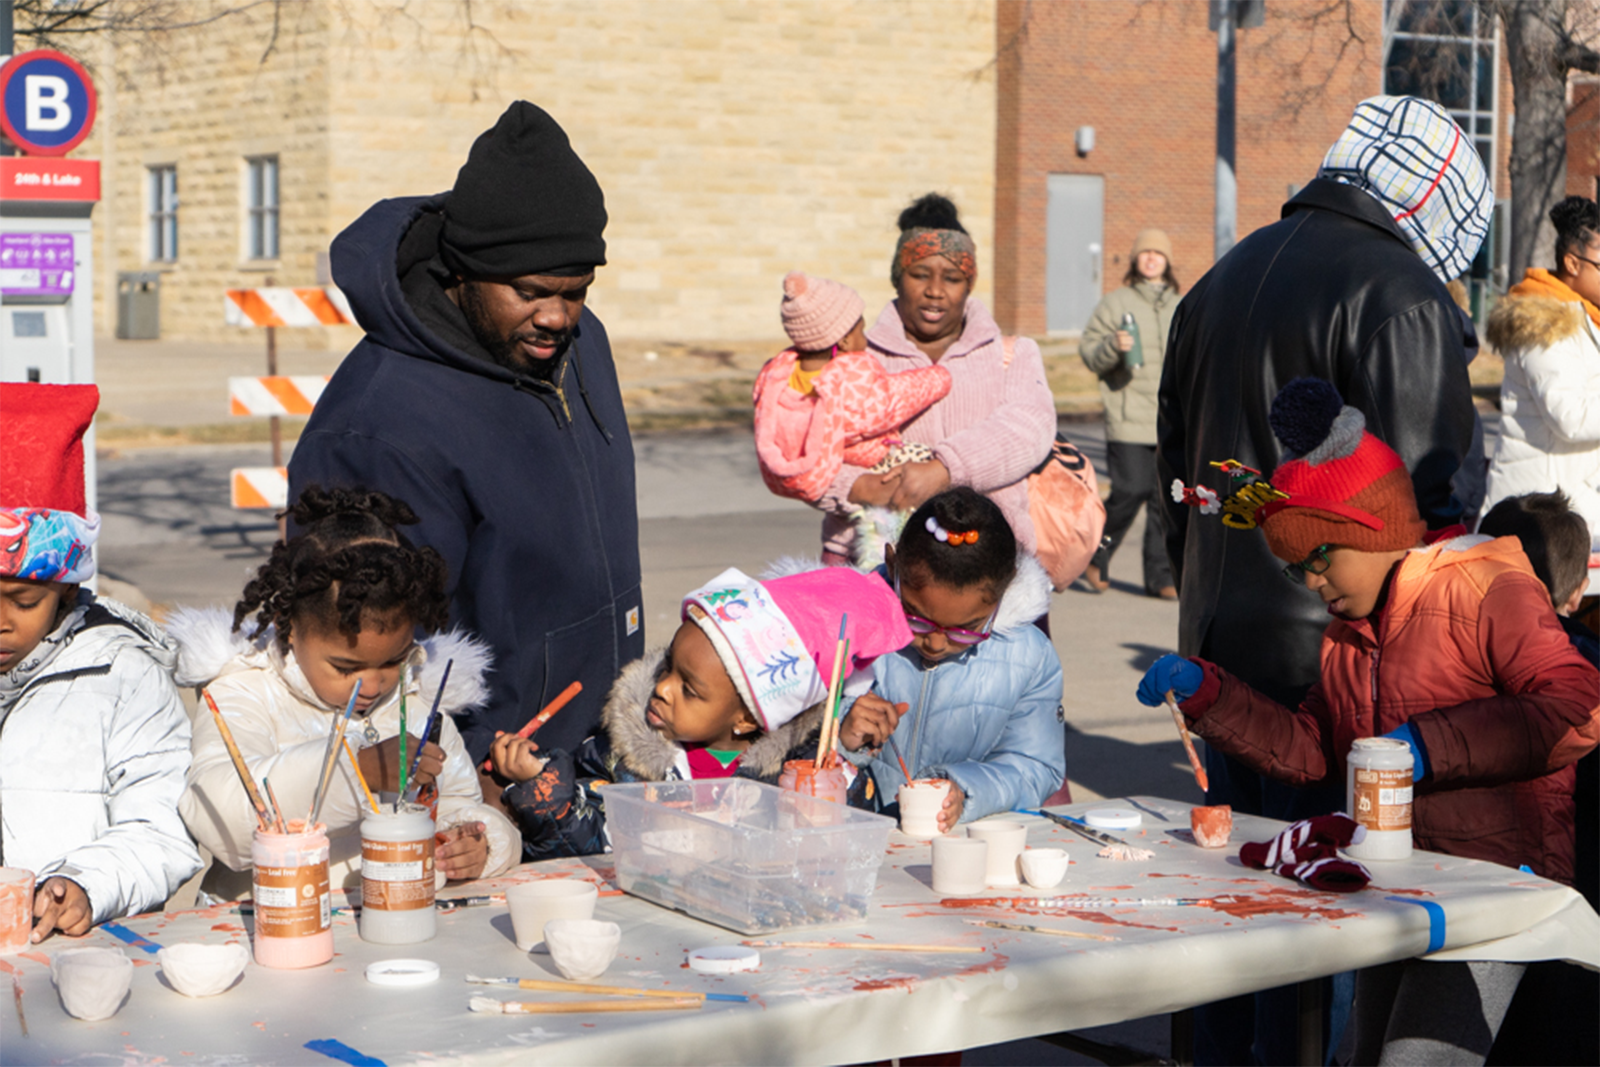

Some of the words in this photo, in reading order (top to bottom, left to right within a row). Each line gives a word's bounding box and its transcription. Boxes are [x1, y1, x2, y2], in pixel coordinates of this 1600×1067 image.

[25, 74, 71, 131] B
[14, 172, 40, 186] 24th
[42, 173, 51, 186] &
[53, 173, 82, 186] Lake
